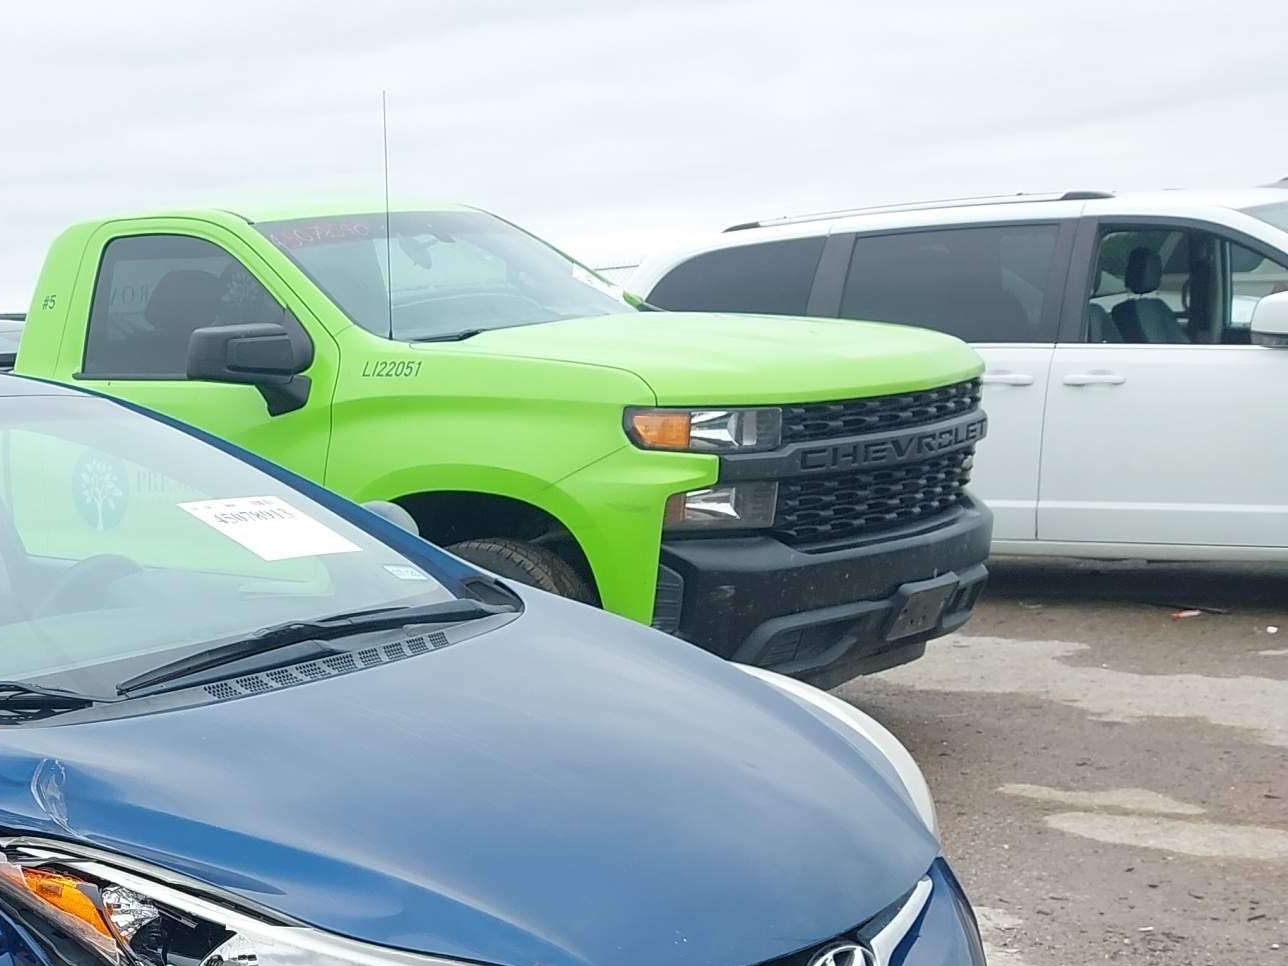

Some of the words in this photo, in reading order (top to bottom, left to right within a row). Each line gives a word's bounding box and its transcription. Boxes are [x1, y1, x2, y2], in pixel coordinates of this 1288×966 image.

[42, 294, 57, 310] #5
[362, 360, 423, 377] LI22051
[800, 417, 988, 470] CHEVROLET
